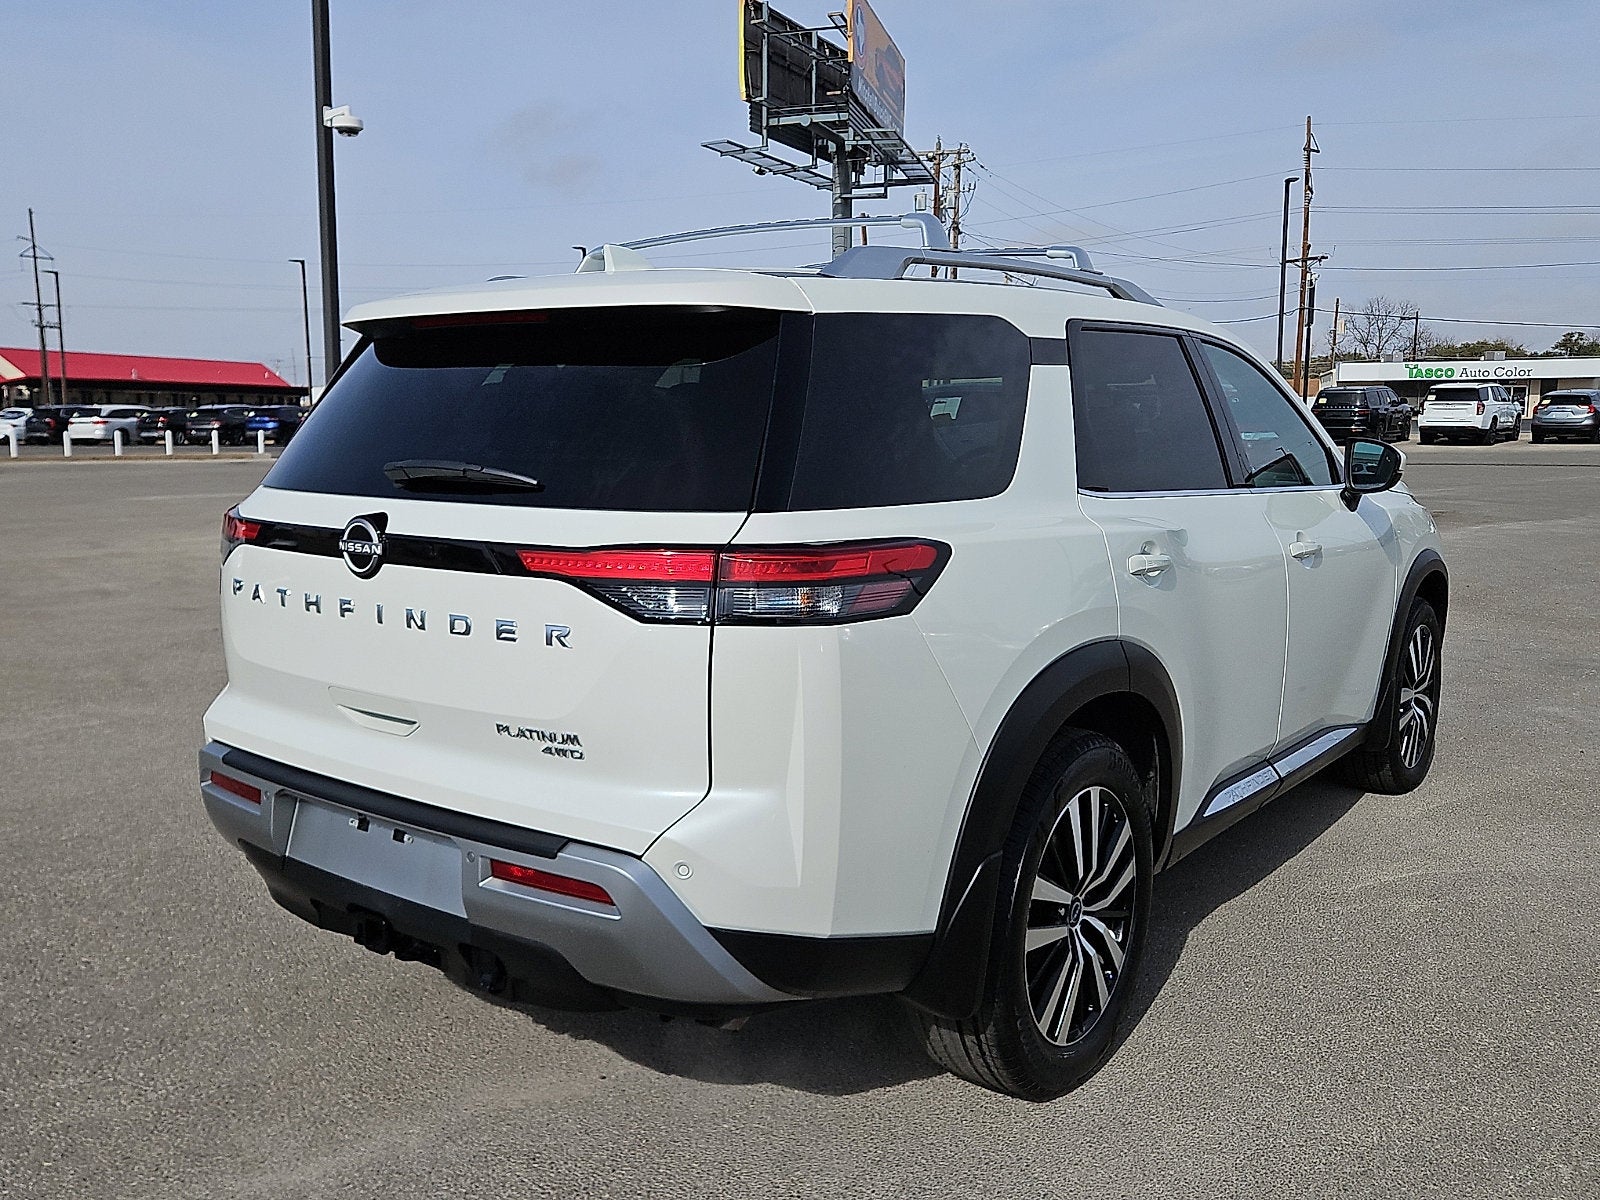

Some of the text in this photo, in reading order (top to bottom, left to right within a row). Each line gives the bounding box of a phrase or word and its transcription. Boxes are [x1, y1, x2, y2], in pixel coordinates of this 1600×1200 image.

[1405, 364, 1533, 378] TASCO Auto Color
[339, 540, 382, 555] NISSAN
[232, 578, 573, 649] PATHFINDER
[495, 722, 582, 747] PLATINUM
[541, 746, 585, 760] 4WD
[1224, 769, 1274, 803] PATHFINDER
